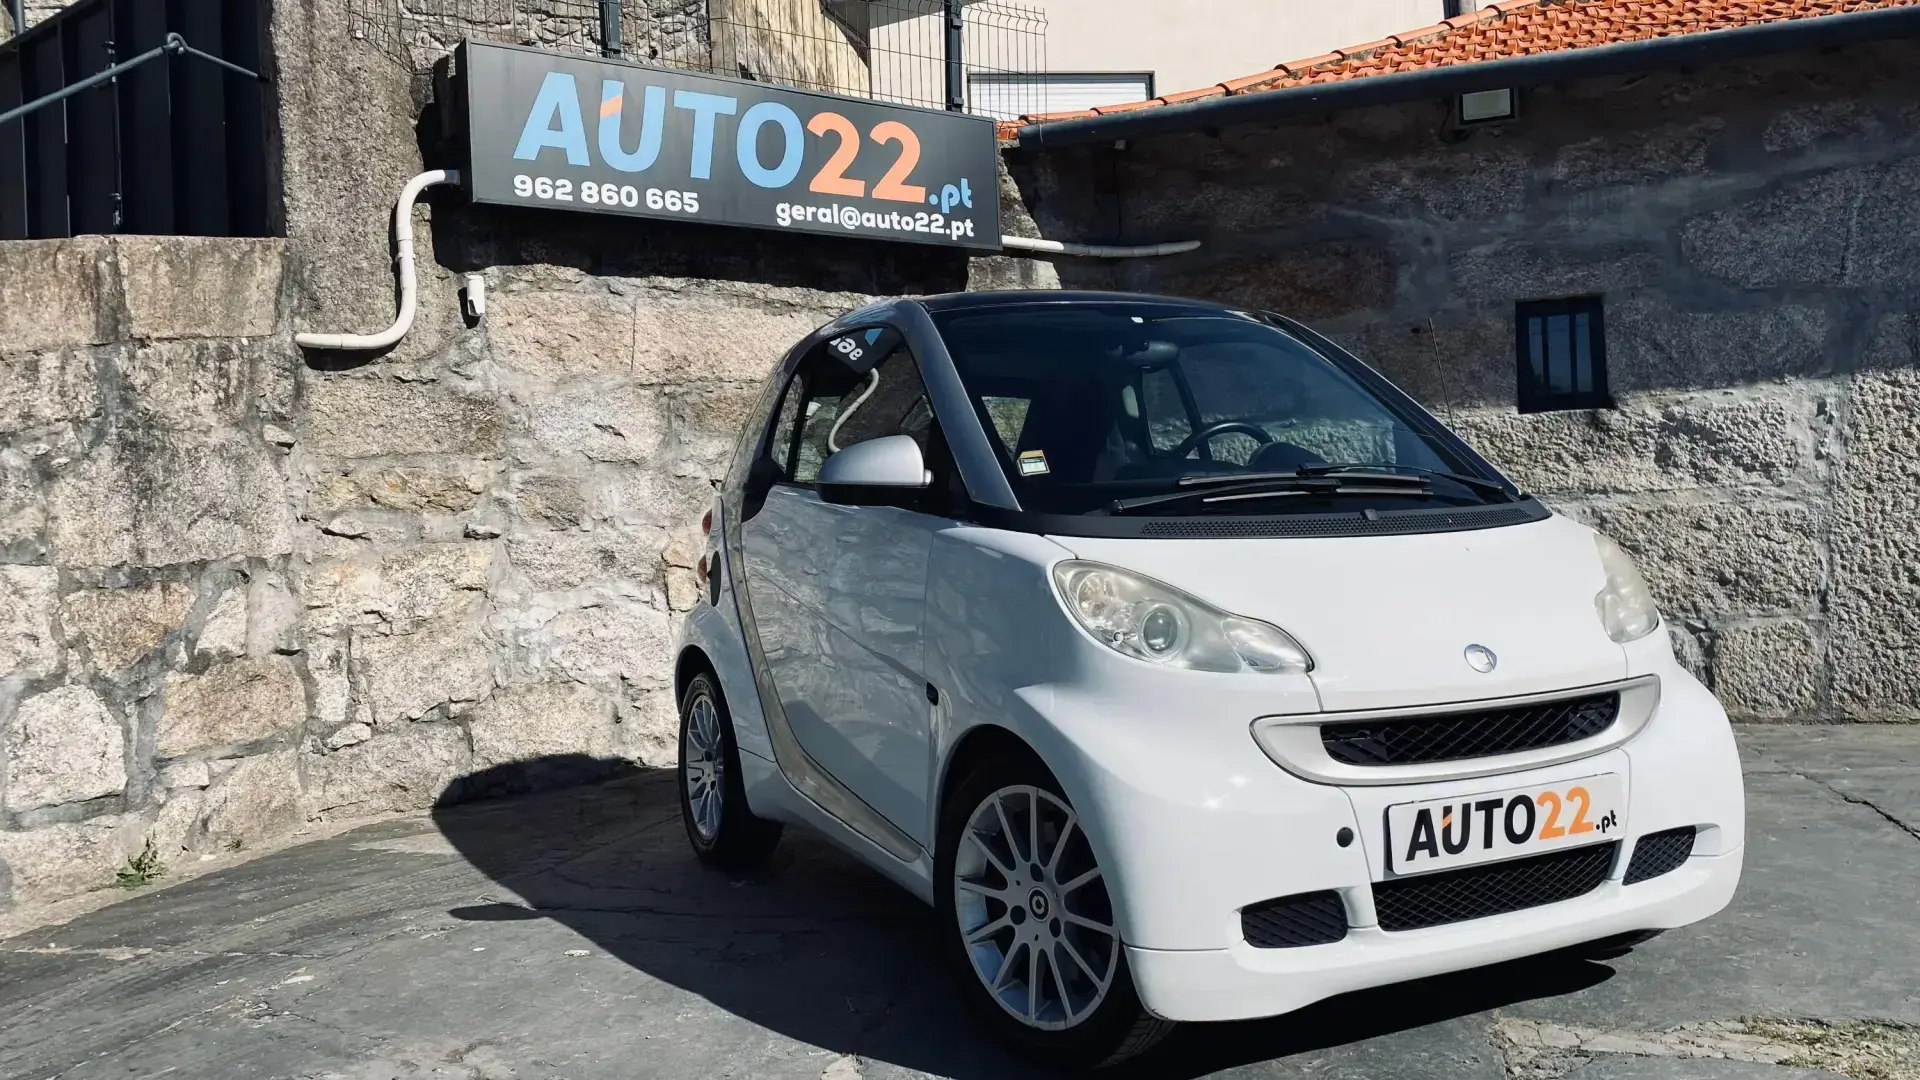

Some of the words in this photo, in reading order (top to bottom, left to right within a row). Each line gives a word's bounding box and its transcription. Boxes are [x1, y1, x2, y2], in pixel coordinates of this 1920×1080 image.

[514, 174, 573, 201] 962
[581, 182, 639, 207] 860
[646, 189, 700, 213] 665
[776, 203, 974, 239] geral@auto22.pt
